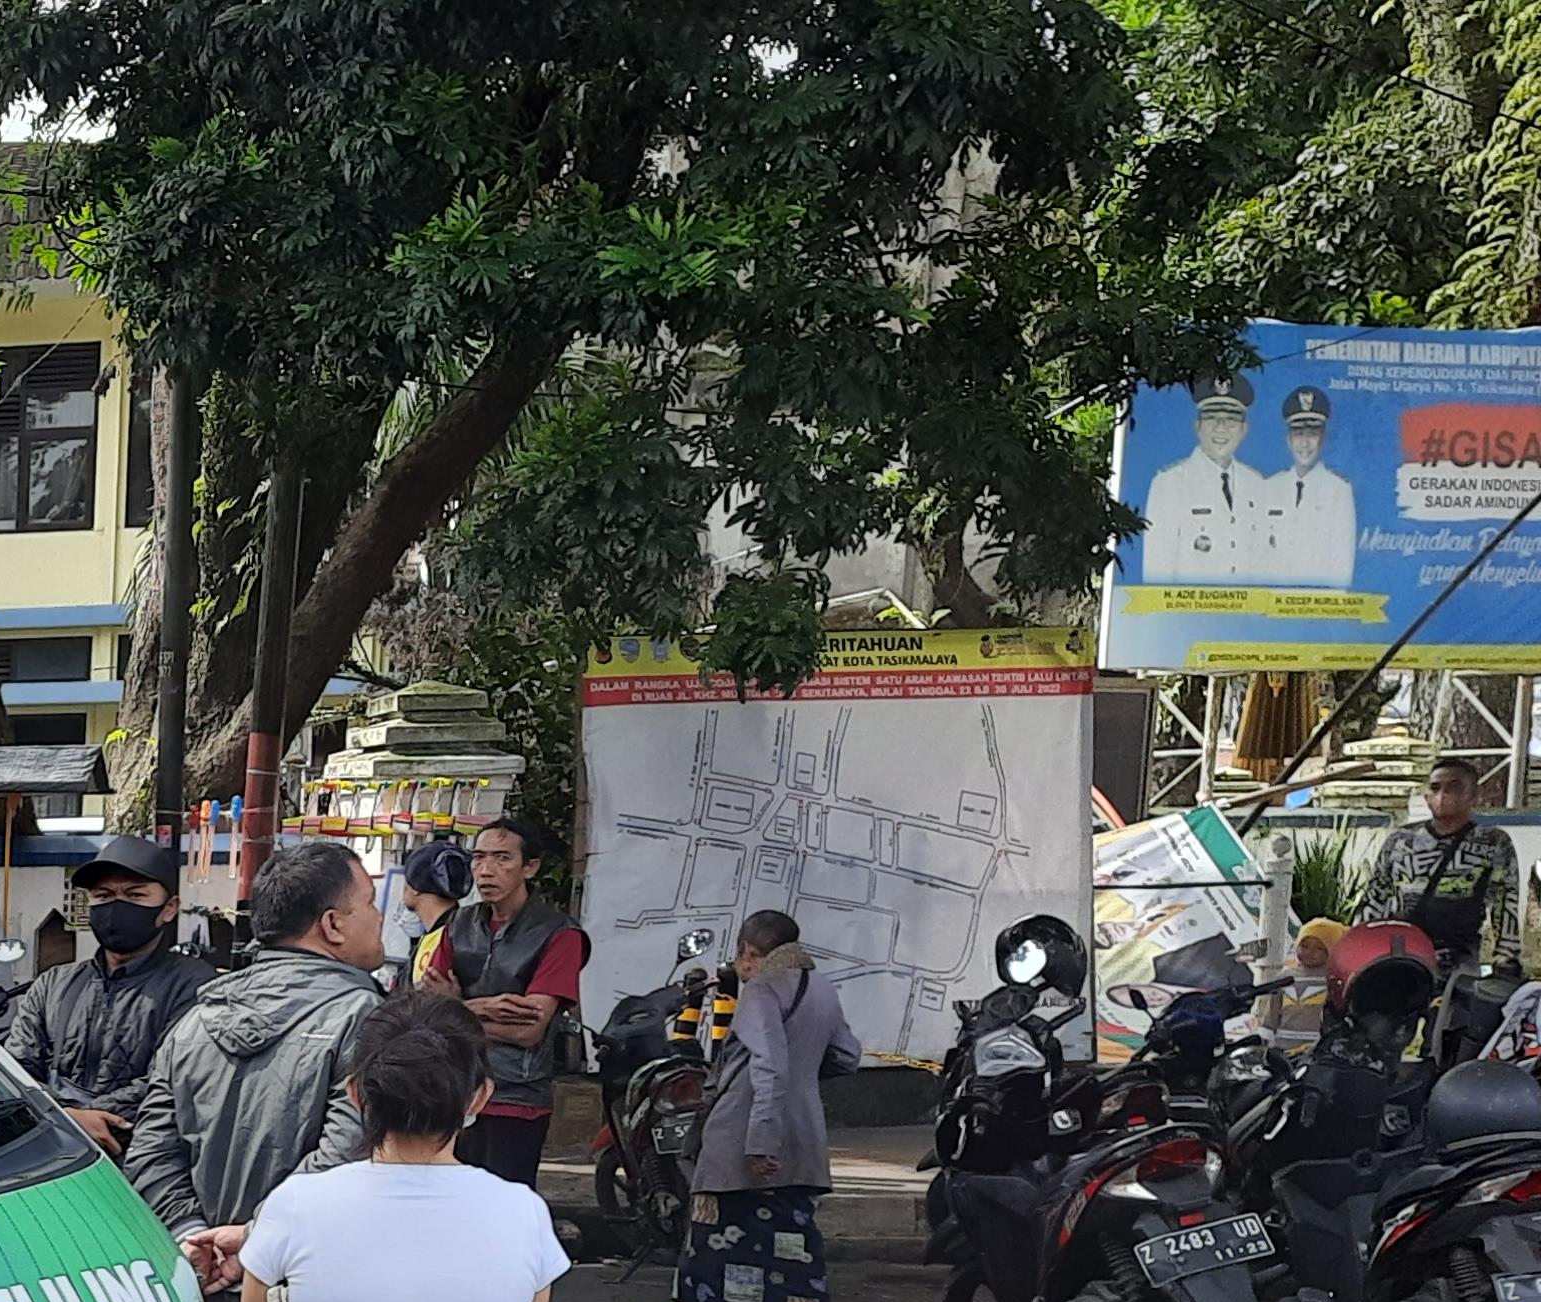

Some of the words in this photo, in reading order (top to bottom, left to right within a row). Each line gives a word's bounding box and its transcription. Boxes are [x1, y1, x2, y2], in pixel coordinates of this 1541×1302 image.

[1306, 339, 1401, 361] PEMERINTAH
[1403, 342, 1466, 363] DAERAH
[1409, 477, 1477, 490] GERAKAN
[1425, 496, 1472, 508] SADAR
[843, 655, 874, 667] KOTA
[877, 655, 958, 667] TASIKMALAYA
[590, 681, 629, 692] DALAM
[634, 680, 680, 690] RANGKA
[1139, 1245, 1156, 1264] Z
[1165, 1229, 1216, 1255] 2483
[1232, 1218, 1261, 1238] UD
[1503, 1282, 1521, 1301] Z
